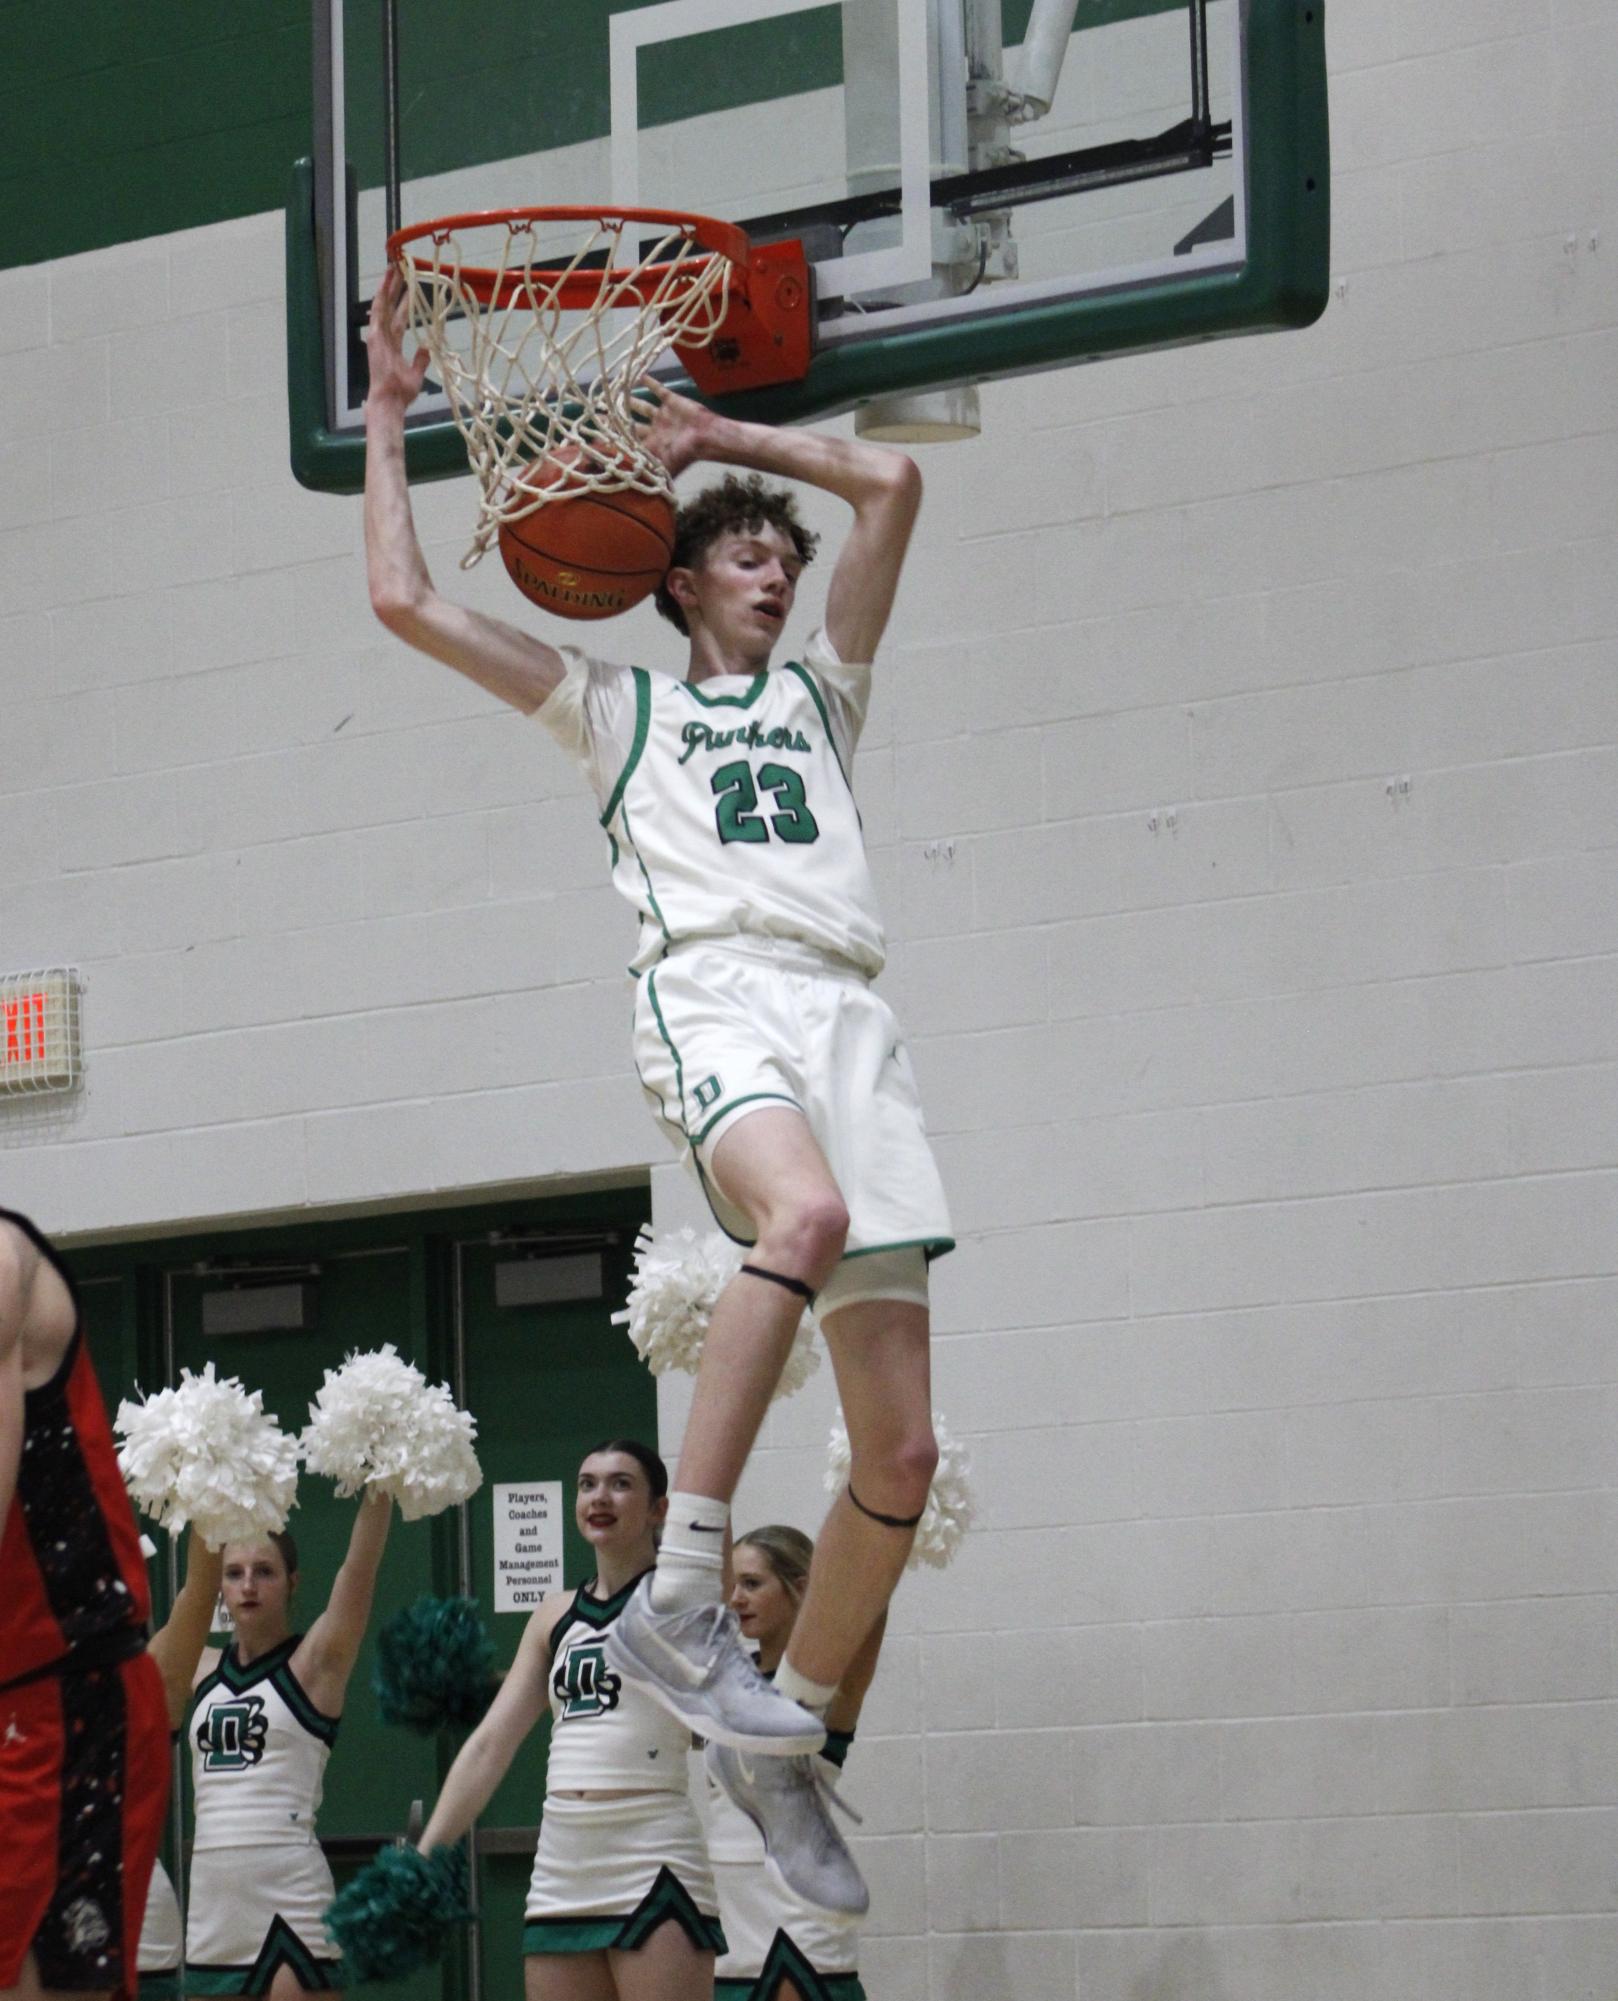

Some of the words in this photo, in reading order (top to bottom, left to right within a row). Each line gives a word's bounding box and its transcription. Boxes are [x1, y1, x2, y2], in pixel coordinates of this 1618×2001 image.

[710, 760, 820, 845] 23
[1, 991, 49, 1066] XIT
[691, 1073, 723, 1111] D
[508, 1493, 548, 1505] Players,
[508, 1508, 548, 1520] Coaches
[519, 1526, 538, 1537] and
[515, 1543, 542, 1553] Game
[499, 1559, 559, 1571] Management
[506, 1574, 552, 1586] Personnel
[512, 1591, 546, 1604] ONLY
